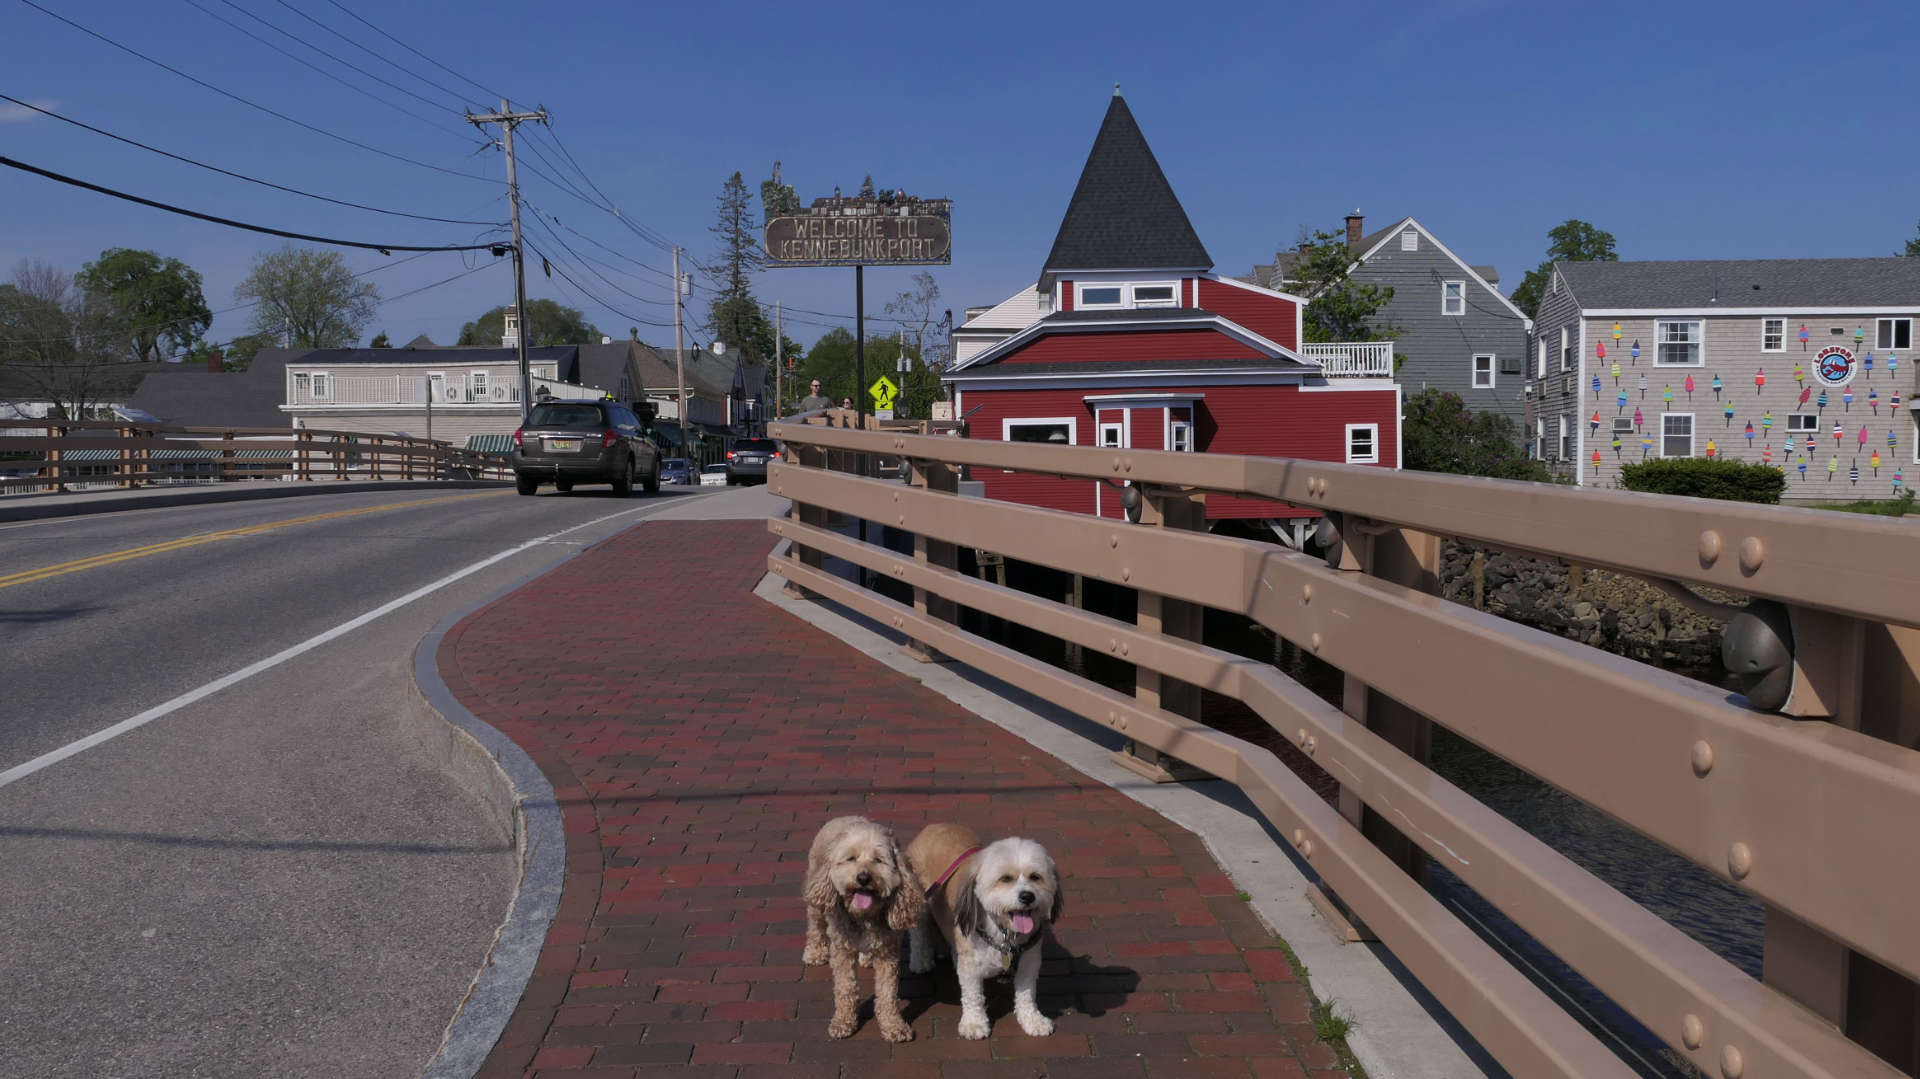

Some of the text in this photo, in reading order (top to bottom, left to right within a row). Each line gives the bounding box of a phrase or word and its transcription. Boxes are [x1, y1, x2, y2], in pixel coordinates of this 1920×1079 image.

[794, 218, 918, 238] WELCOME TO
[780, 238, 934, 259] KENNEBUNKPORT
